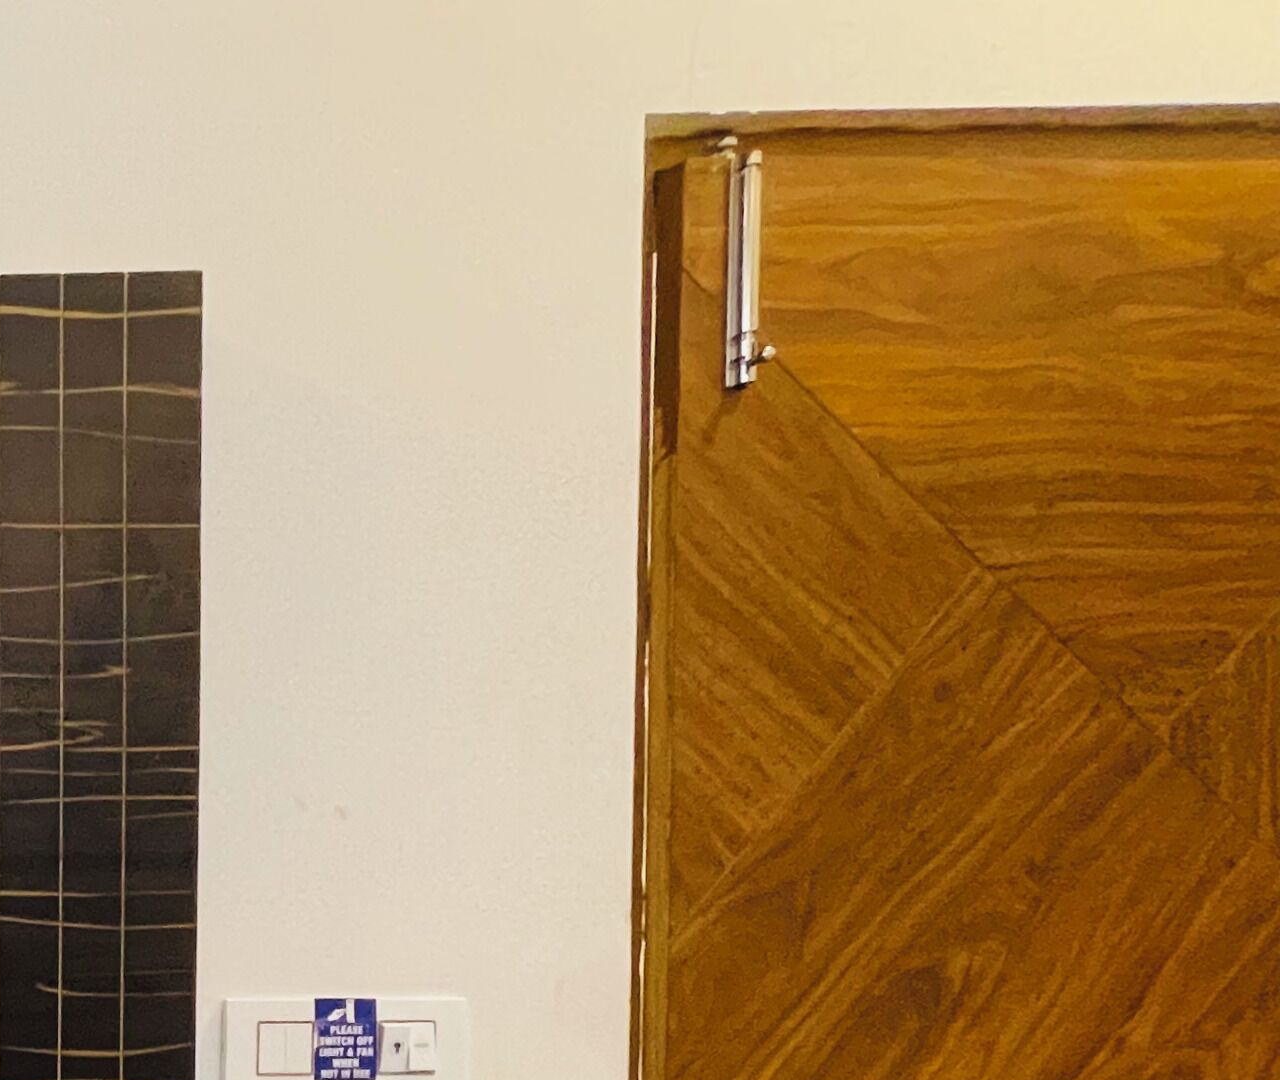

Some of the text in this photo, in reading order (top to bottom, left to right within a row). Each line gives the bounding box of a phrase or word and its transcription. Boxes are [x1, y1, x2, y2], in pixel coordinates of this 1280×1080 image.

[329, 1025, 364, 1035] PLEASE
[356, 1035, 374, 1046] OFF
[356, 1047, 375, 1056] FAN
